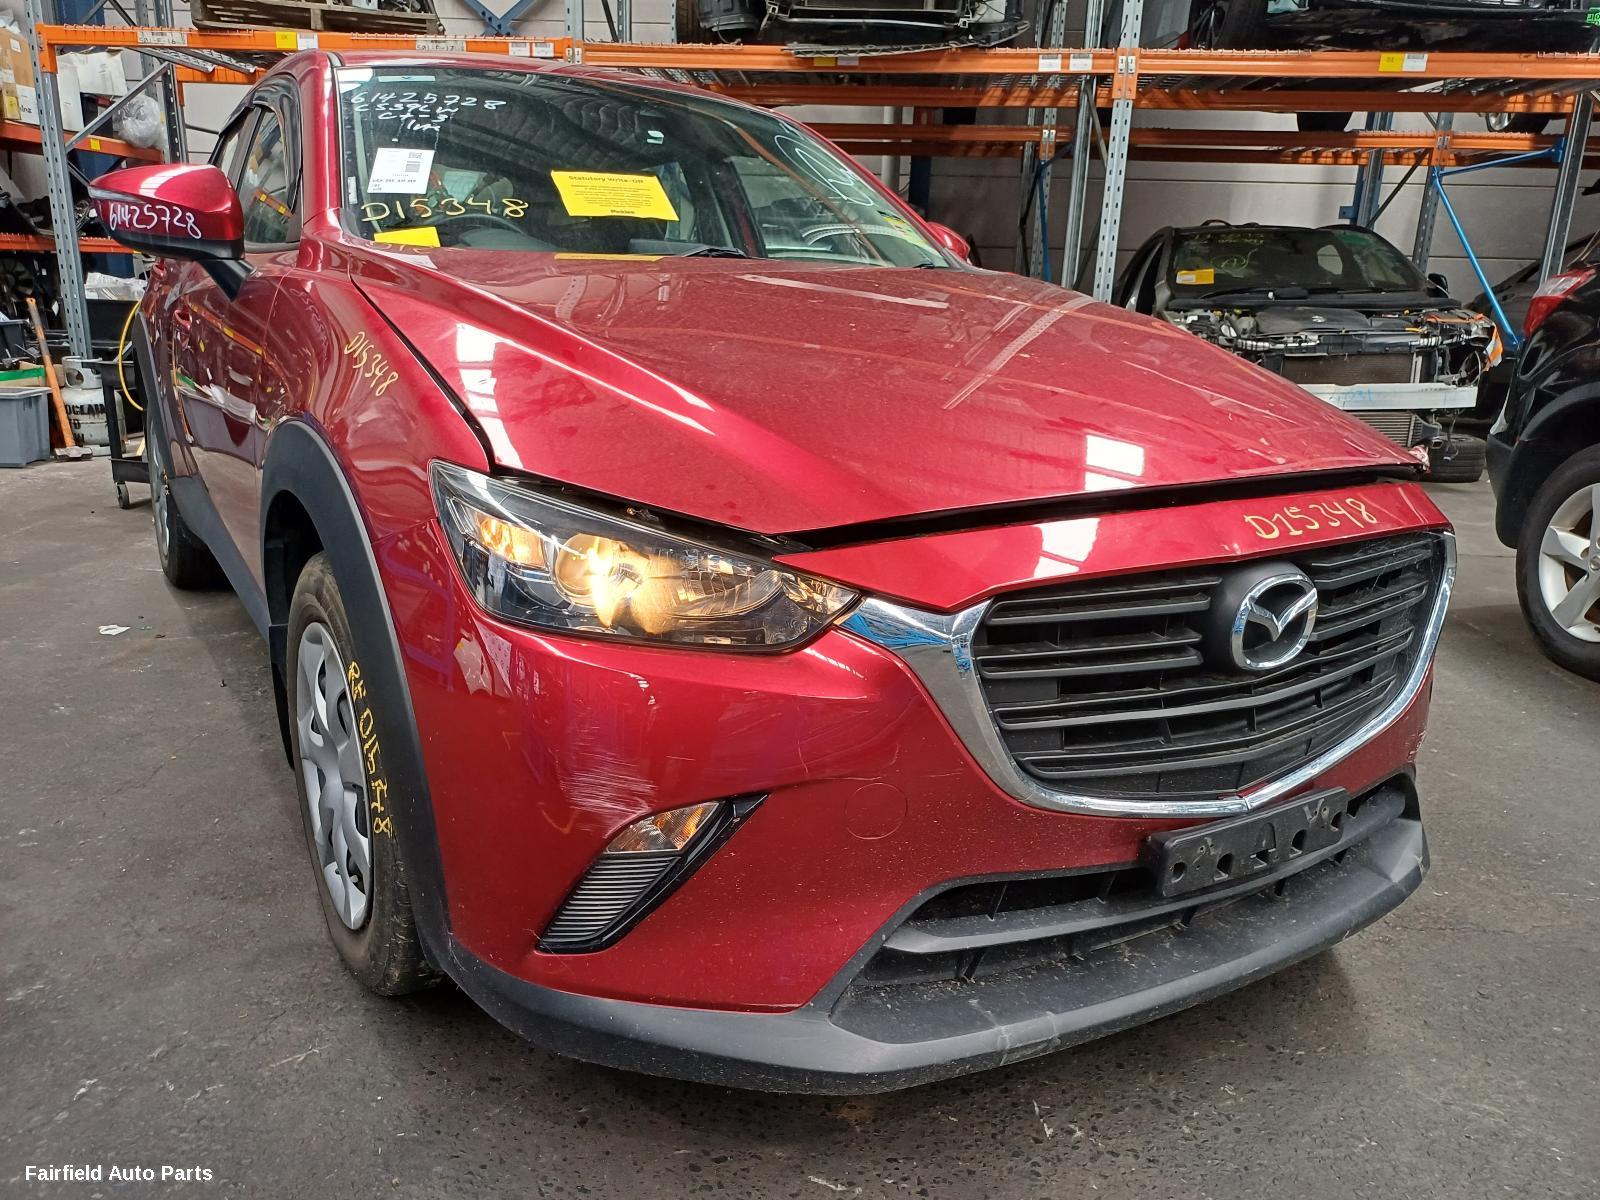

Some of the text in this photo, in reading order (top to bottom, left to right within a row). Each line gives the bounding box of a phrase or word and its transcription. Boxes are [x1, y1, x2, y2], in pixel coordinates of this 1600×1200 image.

[351, 92, 507, 110] 61425728
[109, 202, 202, 239] 61425728
[361, 194, 529, 222] D15348
[343, 331, 399, 396] D15348
[1244, 498, 1377, 539] D15348
